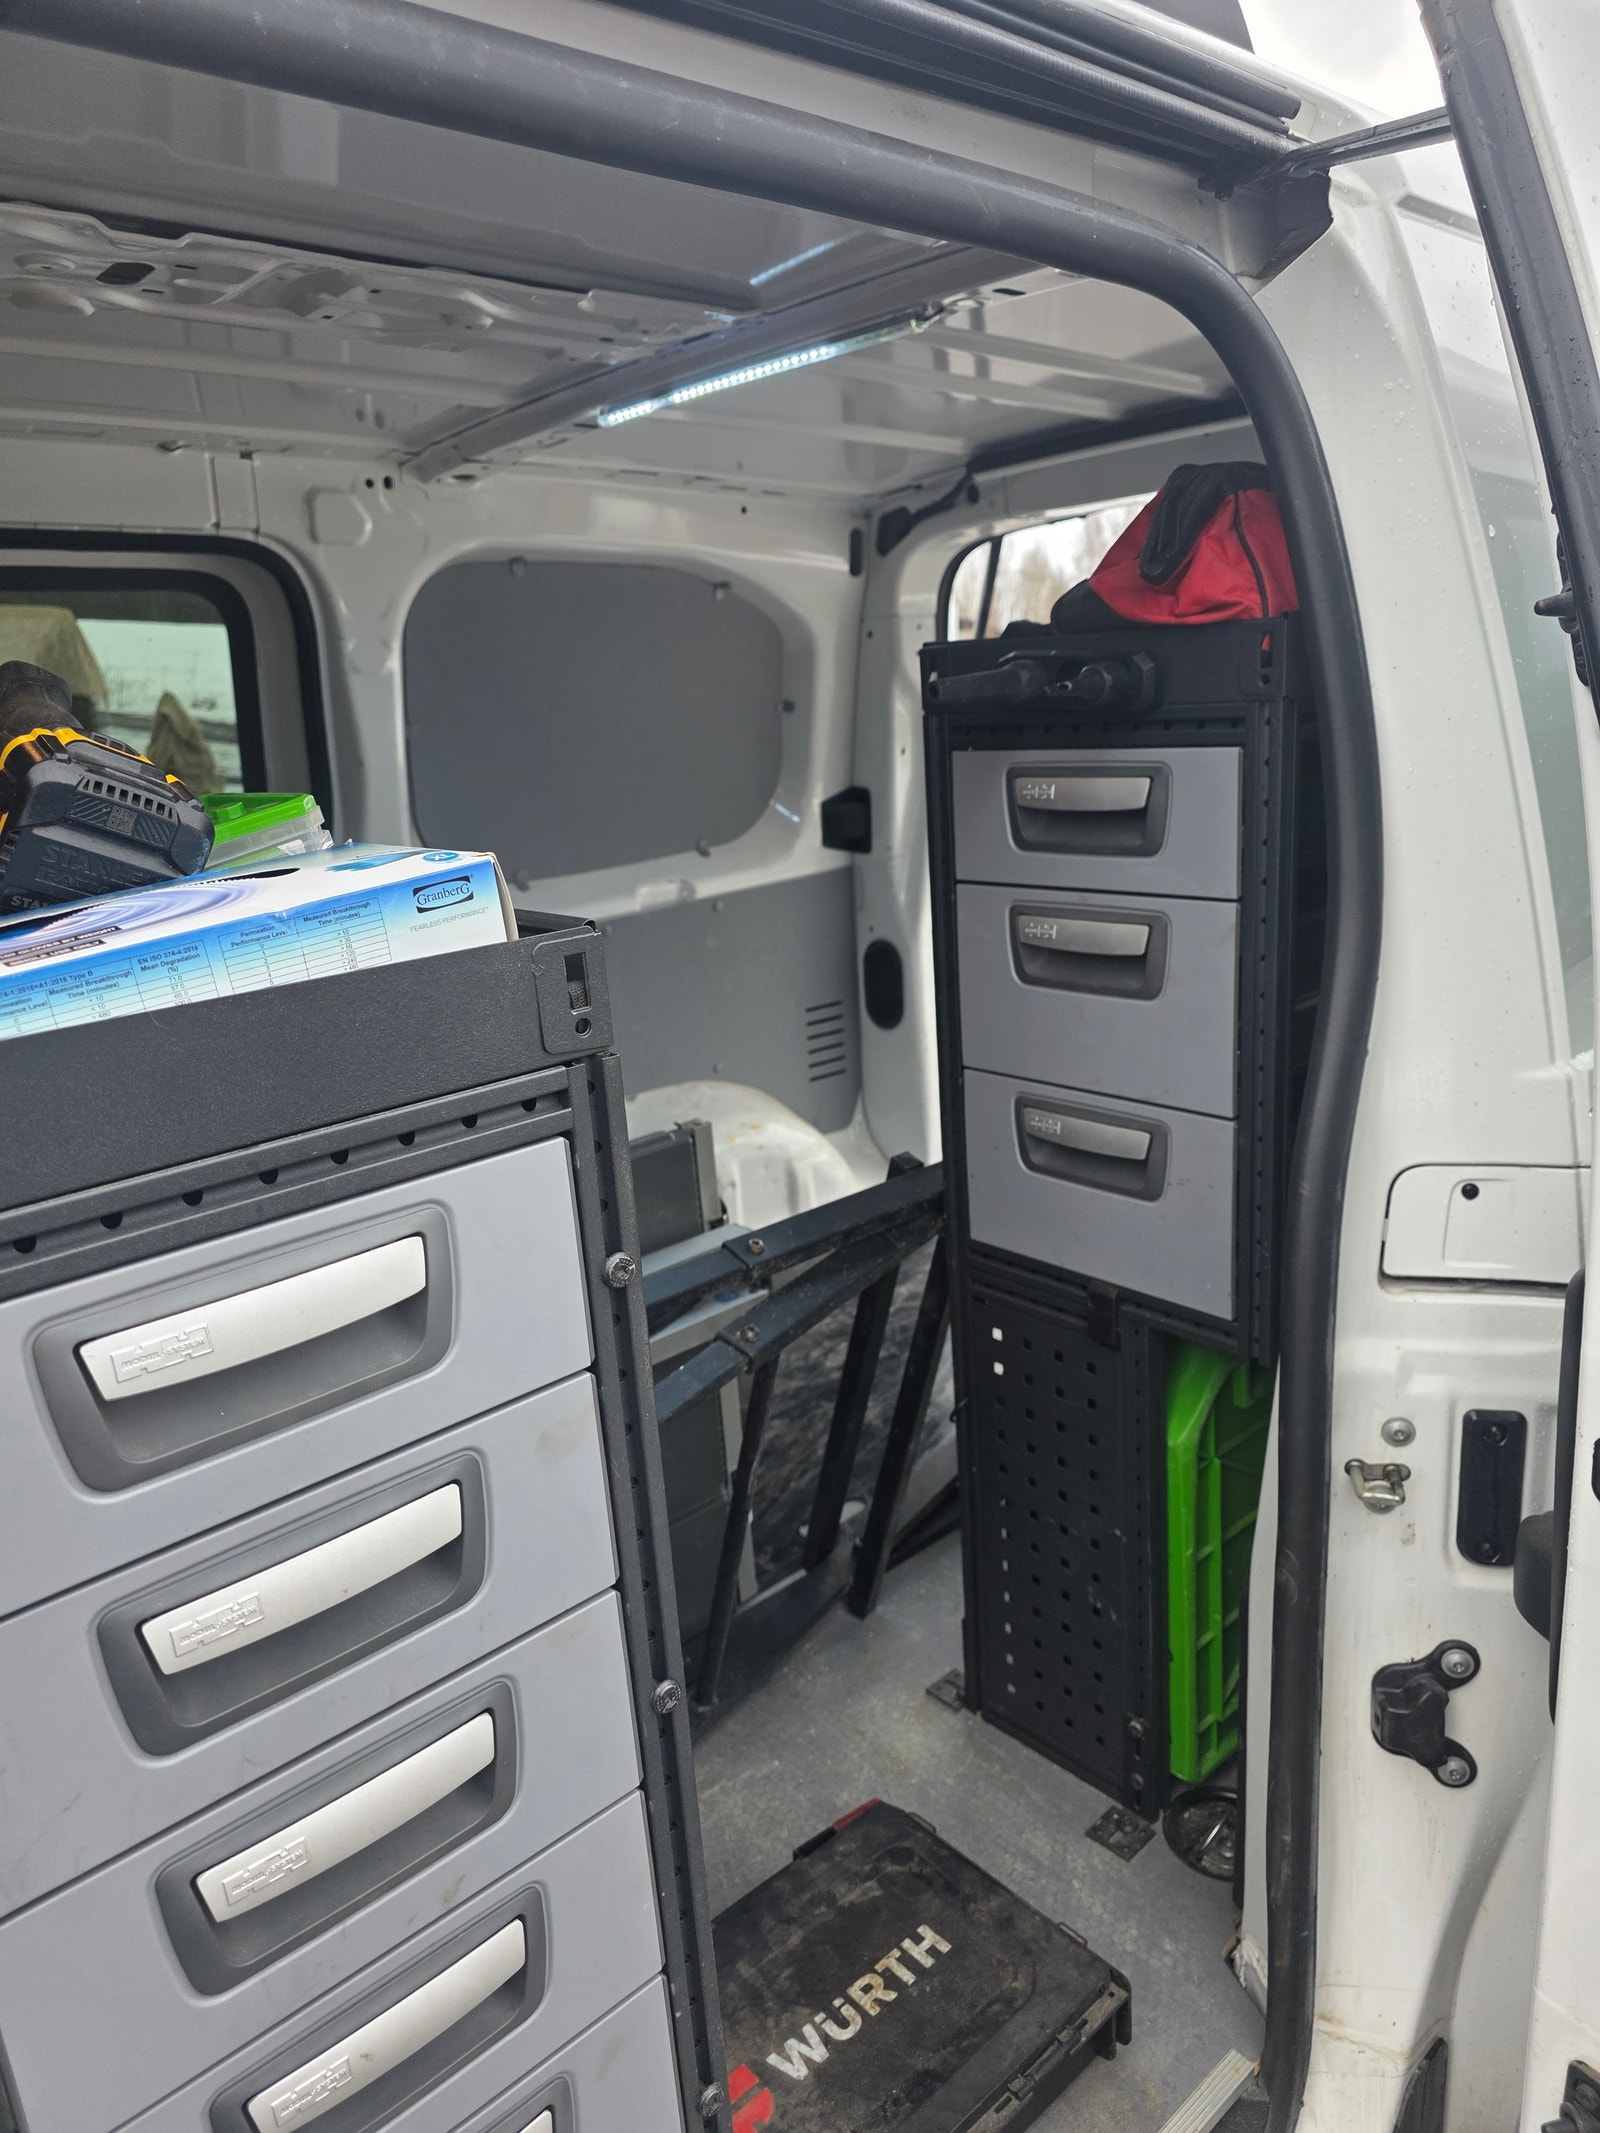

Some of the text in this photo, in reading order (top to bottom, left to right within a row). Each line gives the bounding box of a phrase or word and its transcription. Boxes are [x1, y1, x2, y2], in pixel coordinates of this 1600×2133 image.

[429, 852, 455, 861] XL
[302, 902, 371, 922] Measured Breakthrough
[318, 911, 360, 926] Time (minutes)
[239, 925, 276, 938] Permeation
[410, 920, 441, 933] FEARLESS
[17, 941, 60, 955] GLOVES
[76, 926, 117, 939] WEIGHT
[72, 940, 101, 951] ONLY
[230, 929, 289, 948] Performance Level
[137, 957, 149, 965] EN
[149, 954, 163, 962] ISO
[140, 953, 200, 973] Mean Degradation
[48, 970, 132, 996] Measured Breakthrough
[69, 973, 86, 981] Type
[67, 981, 119, 999] Time (minutes)
[28, 1000, 48, 1010] Level
[765, 1924, 952, 2081] WÜRTH
